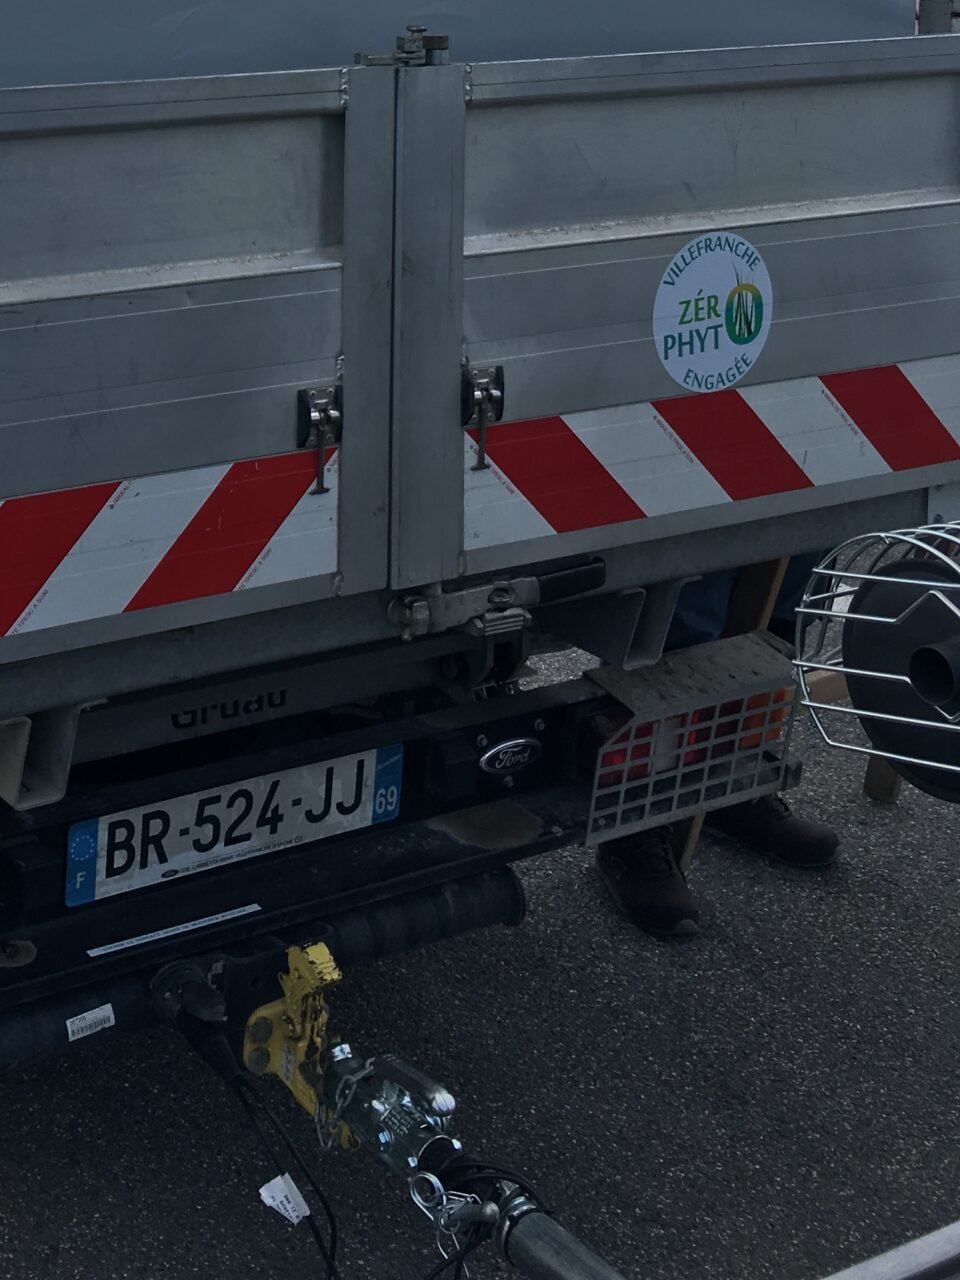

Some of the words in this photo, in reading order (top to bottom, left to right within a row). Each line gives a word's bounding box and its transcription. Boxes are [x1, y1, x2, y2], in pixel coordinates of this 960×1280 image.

[662, 236, 761, 287] VILLEFRANCHE
[683, 353, 753, 390] ENGAGÉE
[495, 746, 530, 769] Ford
[374, 784, 398, 816] 69
[104, 759, 366, 879] BR-524-JJ
[75, 871, 86, 889] F
